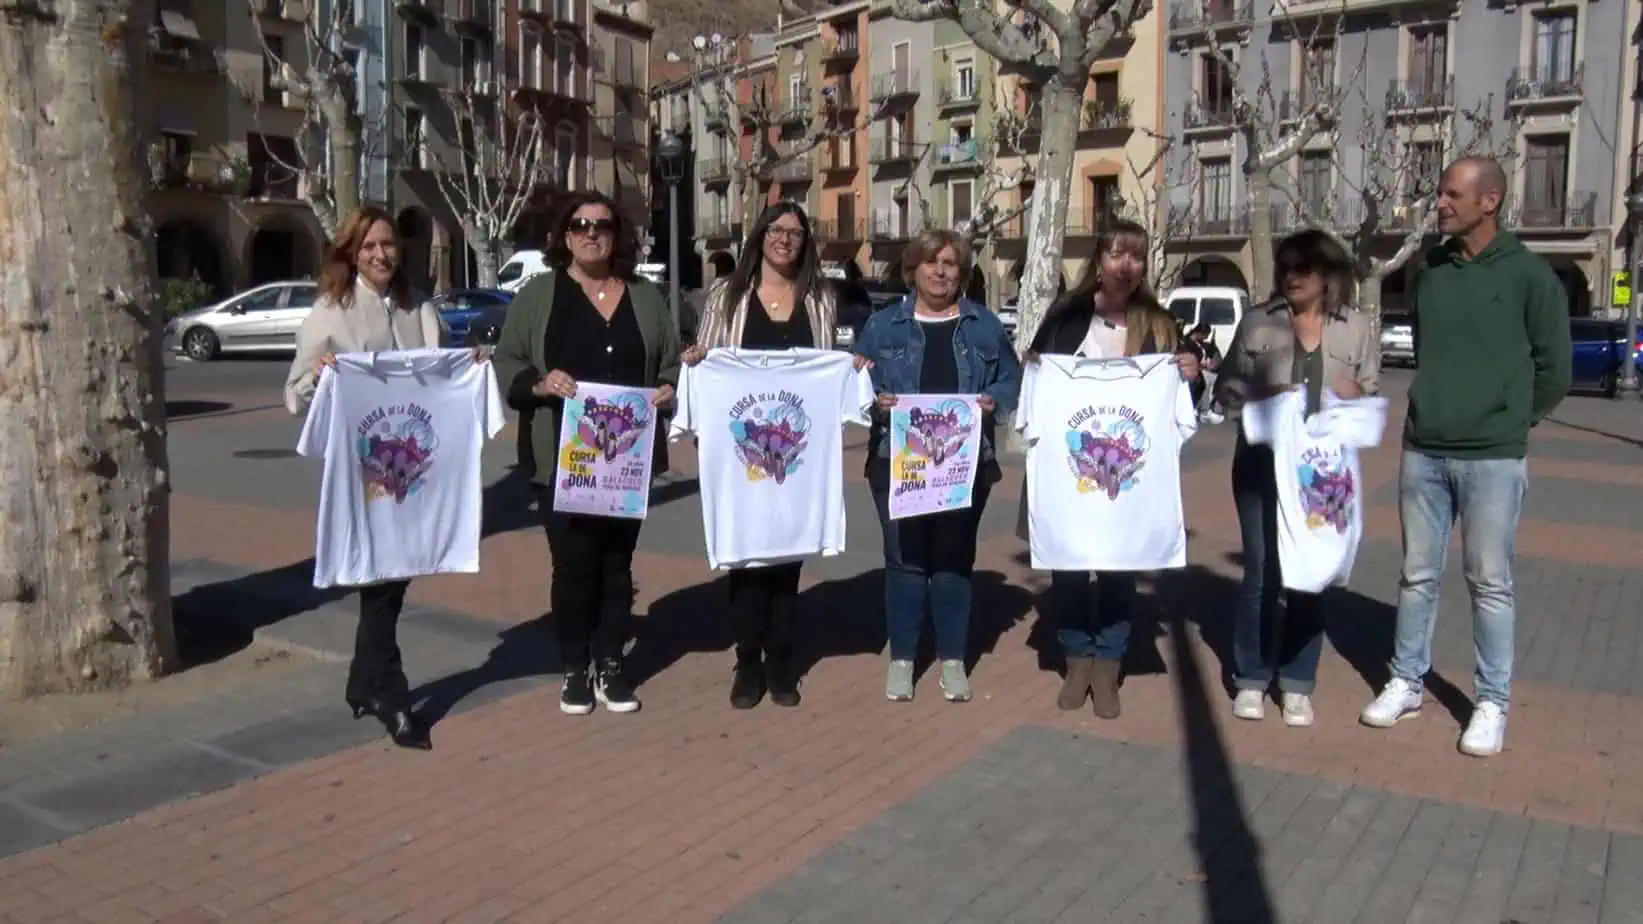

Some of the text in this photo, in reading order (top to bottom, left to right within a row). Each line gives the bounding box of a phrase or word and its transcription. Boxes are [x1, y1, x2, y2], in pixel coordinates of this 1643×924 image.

[728, 393, 757, 420] CURSA
[778, 388, 804, 409] DONA
[357, 406, 386, 435] CURSA
[407, 401, 432, 421] DONA
[1067, 405, 1097, 429] CURSA
[1119, 404, 1145, 426] DONA
[569, 449, 597, 464] CURSA
[568, 473, 597, 489] DONA
[901, 479, 927, 493] DONA
